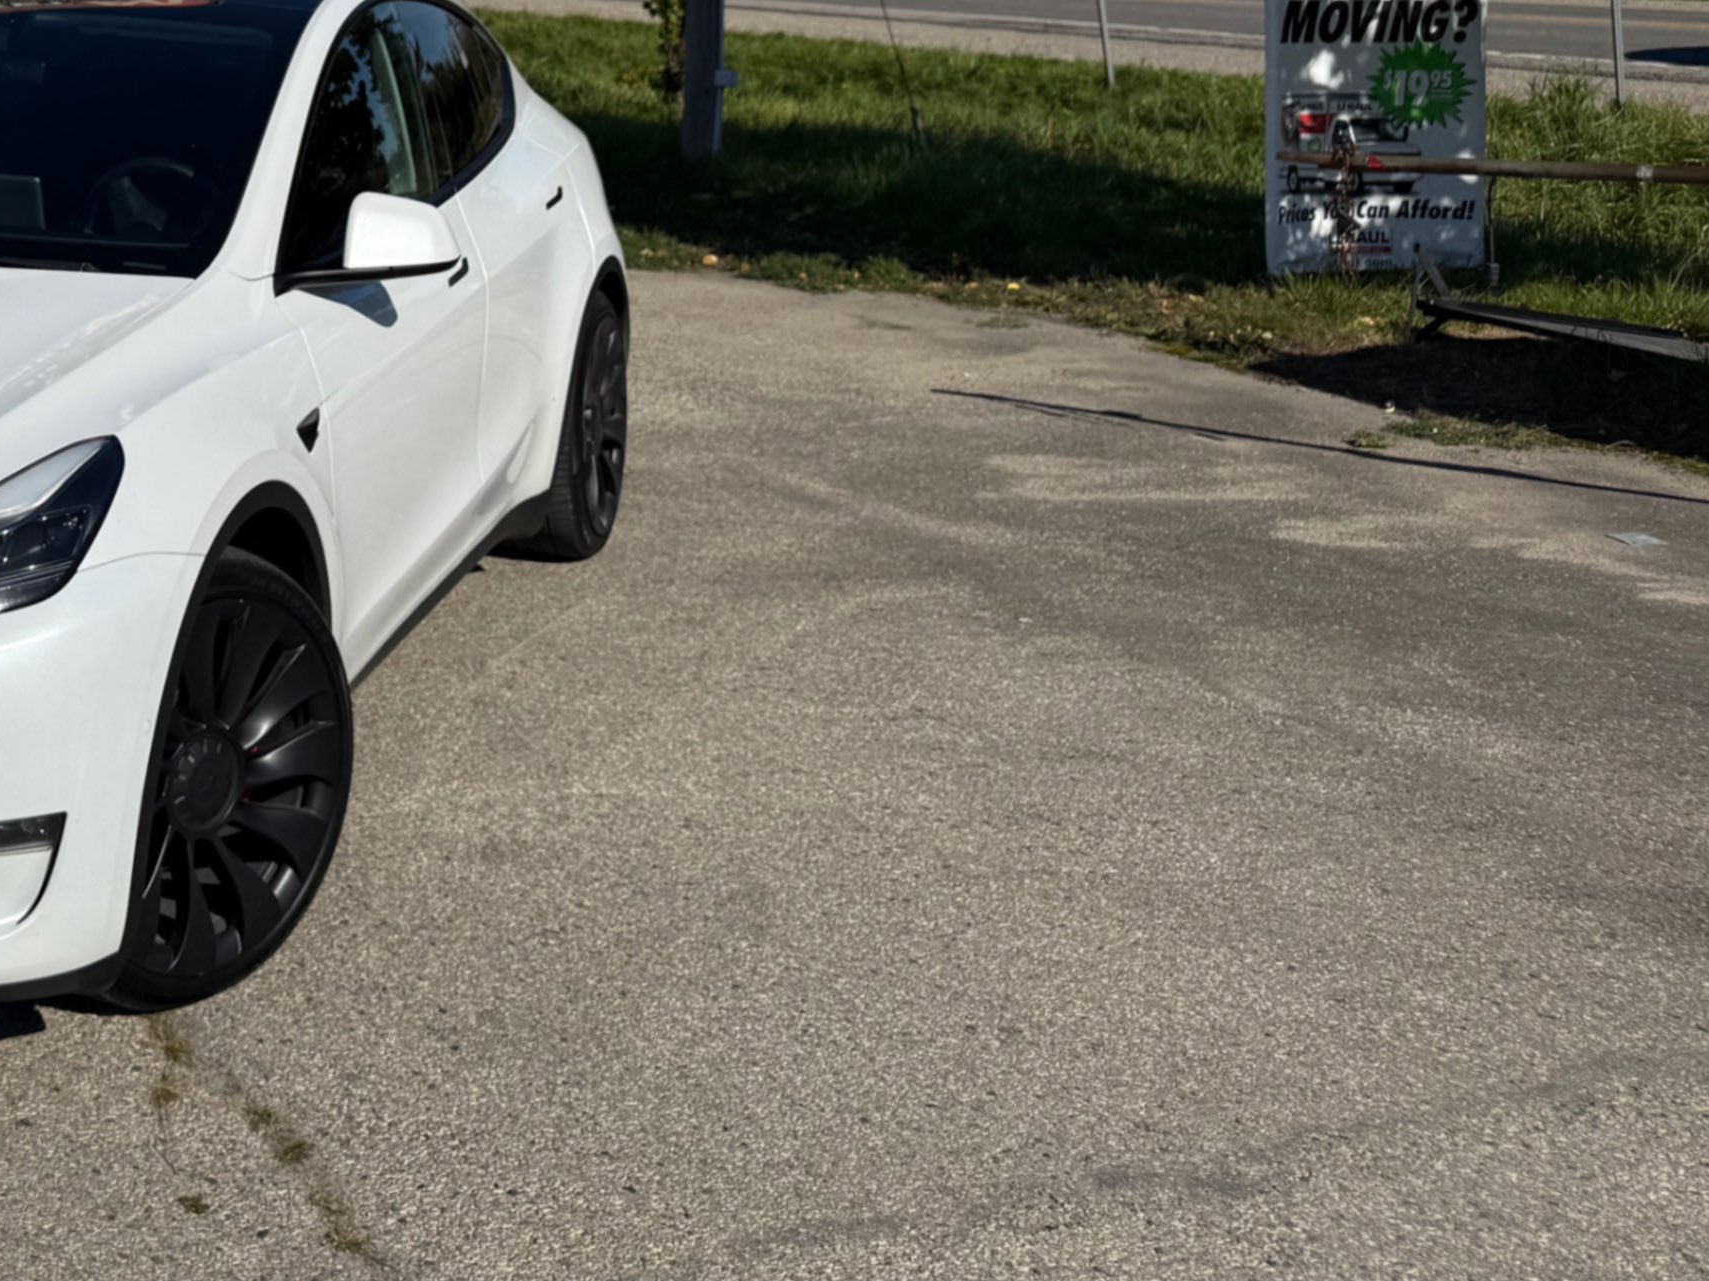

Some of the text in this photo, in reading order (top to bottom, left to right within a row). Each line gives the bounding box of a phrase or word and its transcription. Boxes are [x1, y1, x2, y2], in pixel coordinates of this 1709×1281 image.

[1278, 204, 1317, 225] Prices
[1356, 200, 1390, 219] Can
[1396, 200, 1476, 220] Afford!
